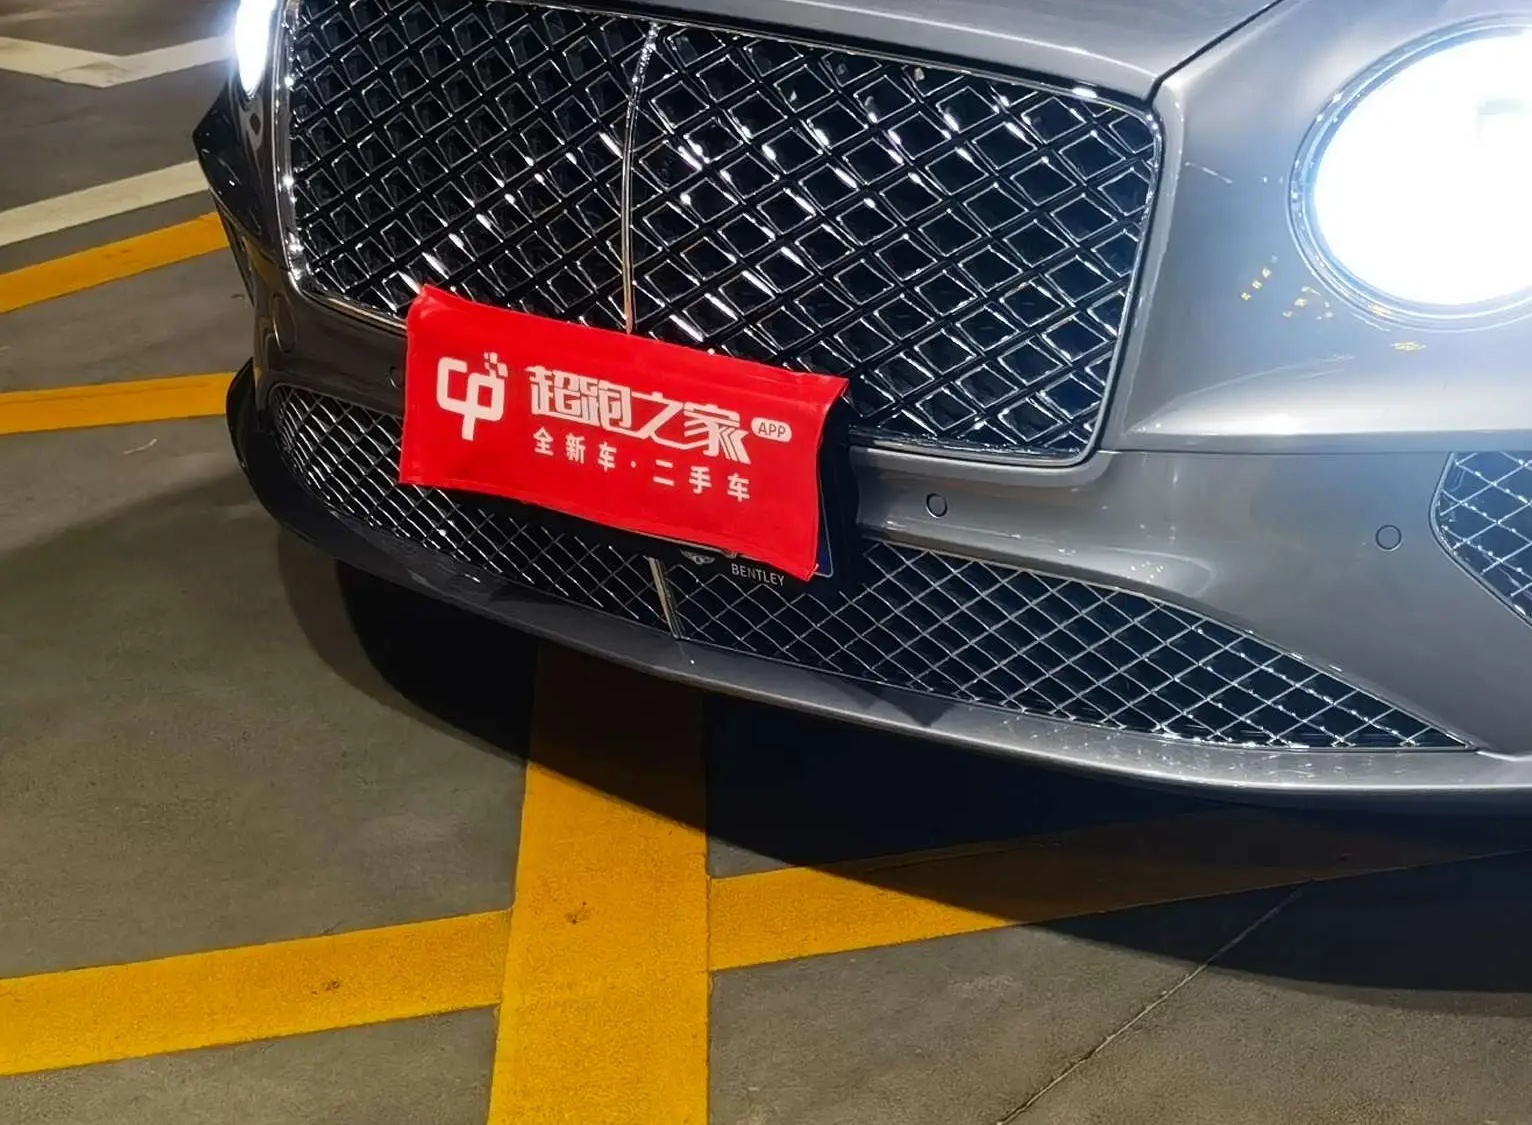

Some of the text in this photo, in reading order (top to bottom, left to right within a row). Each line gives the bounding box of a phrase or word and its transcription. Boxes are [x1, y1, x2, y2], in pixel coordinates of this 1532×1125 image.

[525, 365, 787, 465] 超跑之家 APP
[731, 563, 785, 587] BENTLEY
